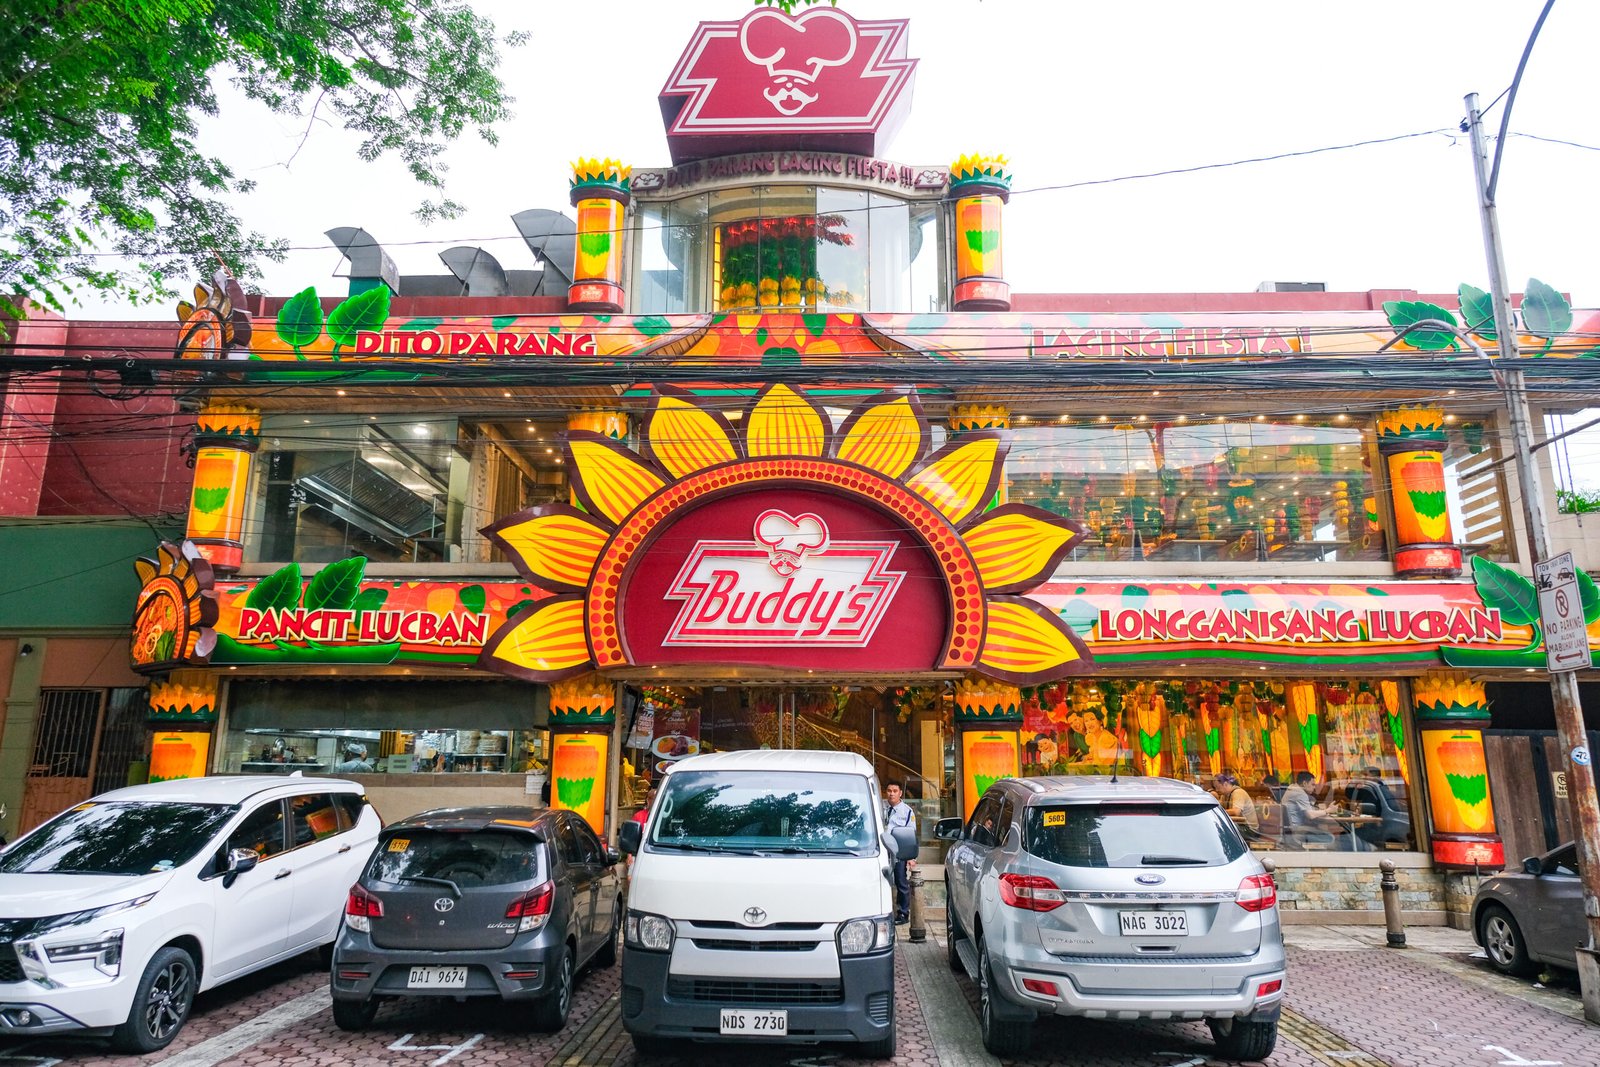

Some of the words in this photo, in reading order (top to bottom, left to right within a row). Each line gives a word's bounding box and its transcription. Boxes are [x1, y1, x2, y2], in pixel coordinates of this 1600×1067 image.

[779, 152, 842, 175] LAGING
[355, 330, 444, 357] DITO
[450, 330, 598, 357] PARANG
[1031, 326, 1168, 358] LAGING
[1538, 563, 1549, 573] TOW
[694, 569, 875, 637] Buddy's
[237, 607, 356, 641] PANCIT
[358, 609, 490, 646] LUCBAN
[1098, 606, 1361, 643] LONGGANISANG
[1367, 606, 1504, 643] LUCBAN
[1546, 621, 1558, 635] NO
[1560, 617, 1582, 631] PARKING
[1048, 814, 1065, 823] 5603
[1122, 916, 1147, 931] NAG
[1155, 916, 1186, 931] 3022
[410, 971, 430, 983] DAI
[437, 971, 466, 985] 9674
[722, 1015, 746, 1029] NDS
[754, 1016, 784, 1030] 2730
